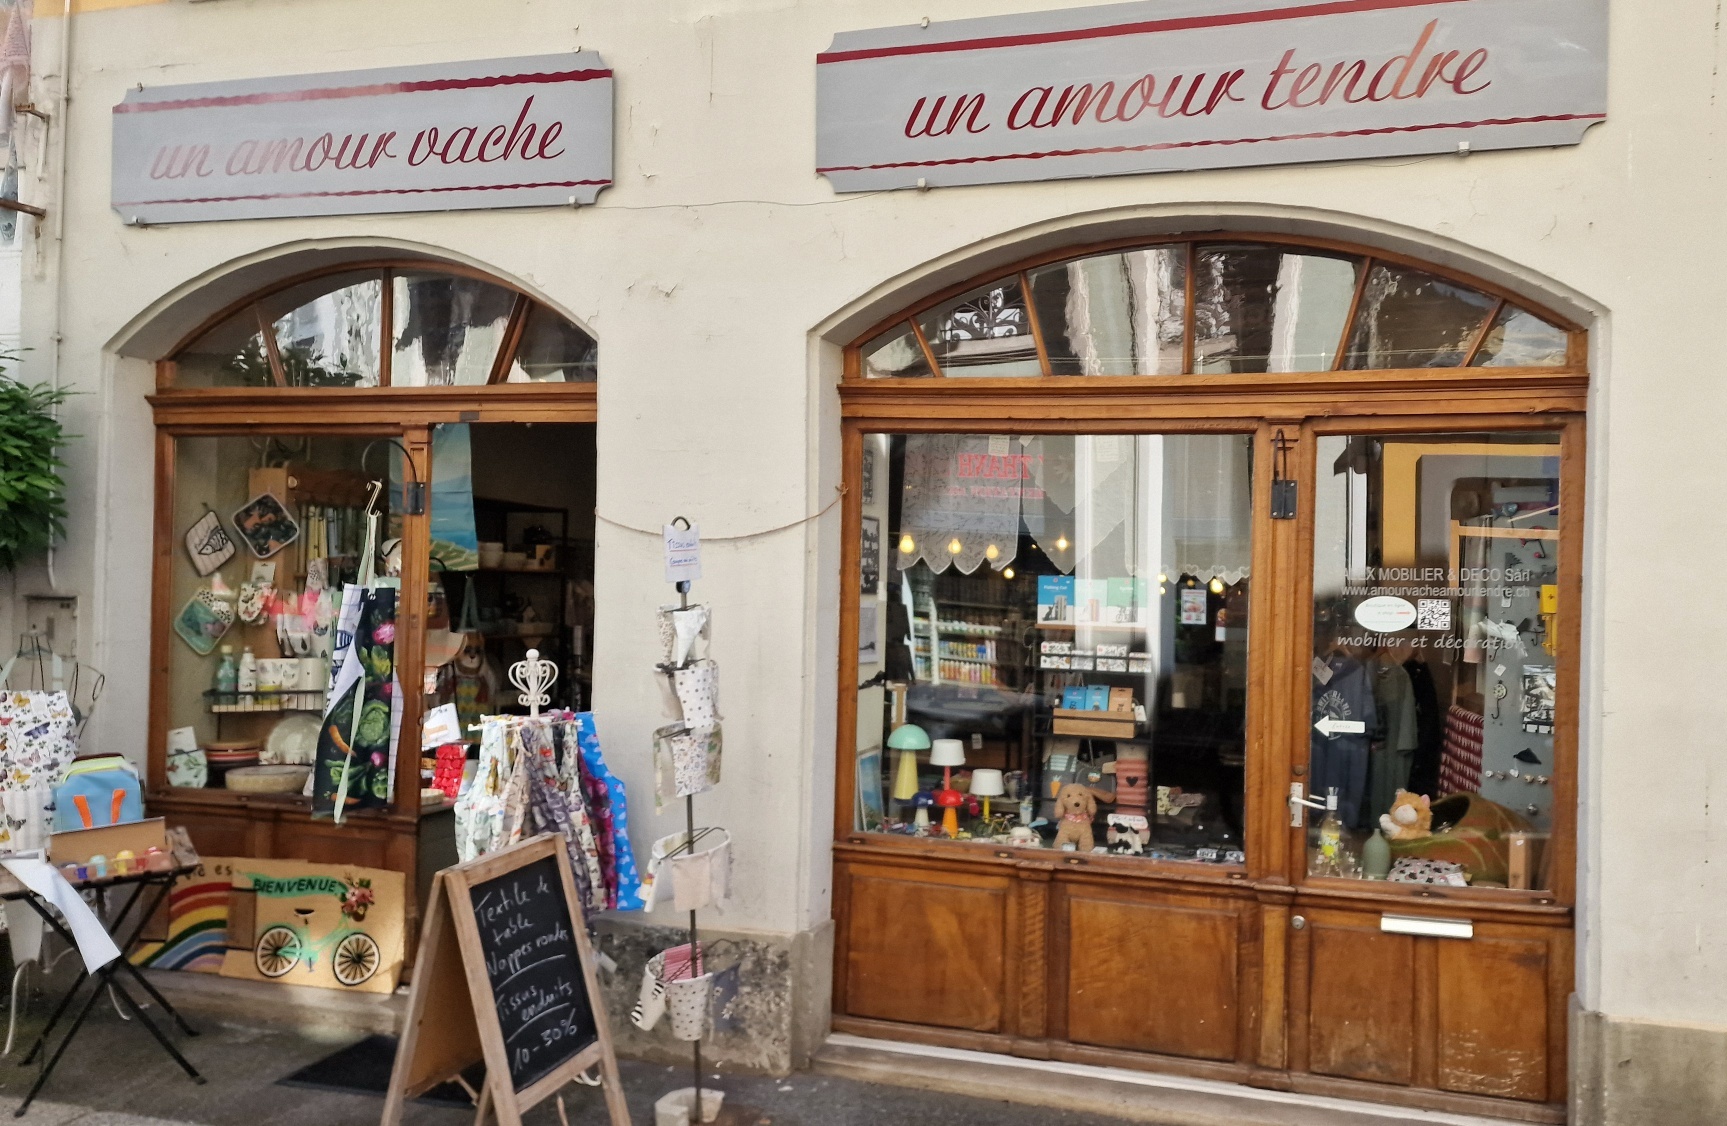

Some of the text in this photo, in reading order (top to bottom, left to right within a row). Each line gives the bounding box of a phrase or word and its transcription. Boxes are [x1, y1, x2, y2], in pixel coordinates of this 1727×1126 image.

[904, 17, 1492, 139] un amour tendre
[149, 94, 566, 180] un amour vache
[1342, 567, 1376, 581] AX
[1378, 567, 1444, 581] MOBILIER
[1447, 568, 1456, 582] &
[1460, 567, 1501, 582] DECO
[1337, 631, 1405, 648] mobilier
[1411, 635, 1429, 648] et
[253, 878, 338, 894] BIENVENUE
[473, 881, 531, 928] Textile
